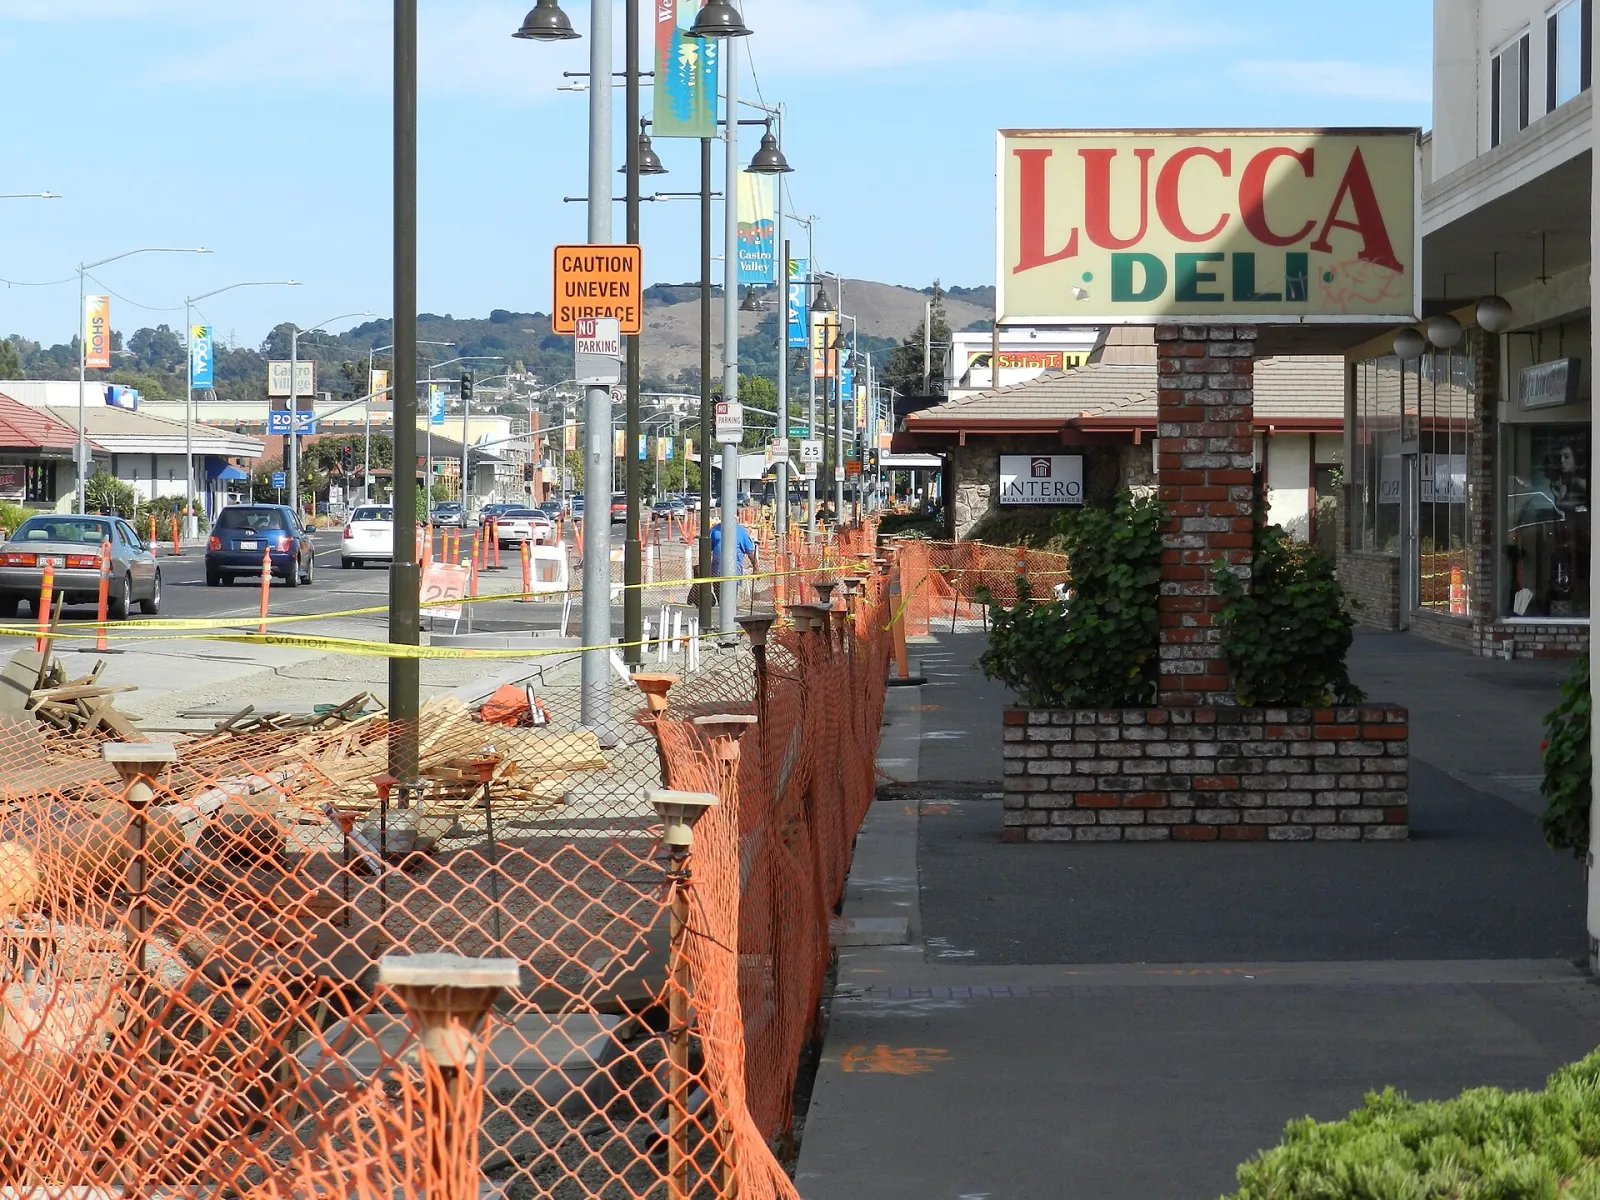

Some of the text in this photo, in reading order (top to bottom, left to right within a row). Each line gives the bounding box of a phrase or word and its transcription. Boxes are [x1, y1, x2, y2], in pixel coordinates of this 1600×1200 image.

[1013, 145, 1404, 274] LUCCA
[739, 249, 771, 260] Castro
[562, 256, 633, 273] CAUTION
[740, 261, 769, 274] Valley
[1111, 252, 1308, 302] DELI
[565, 281, 630, 297] UNEVEN
[560, 306, 634, 322] SURFACE
[92, 317, 104, 354] SHOP
[578, 321, 594, 336] NO
[578, 340, 617, 353] PARKING
[198, 337, 208, 374] LOCAL
[999, 354, 1059, 368] SPIRIT
[273, 364, 311, 377] Casro
[272, 378, 311, 394] Villge
[718, 416, 741, 424] PARKING
[804, 447, 819, 456] 25
[1003, 481, 1080, 497] INTERO
